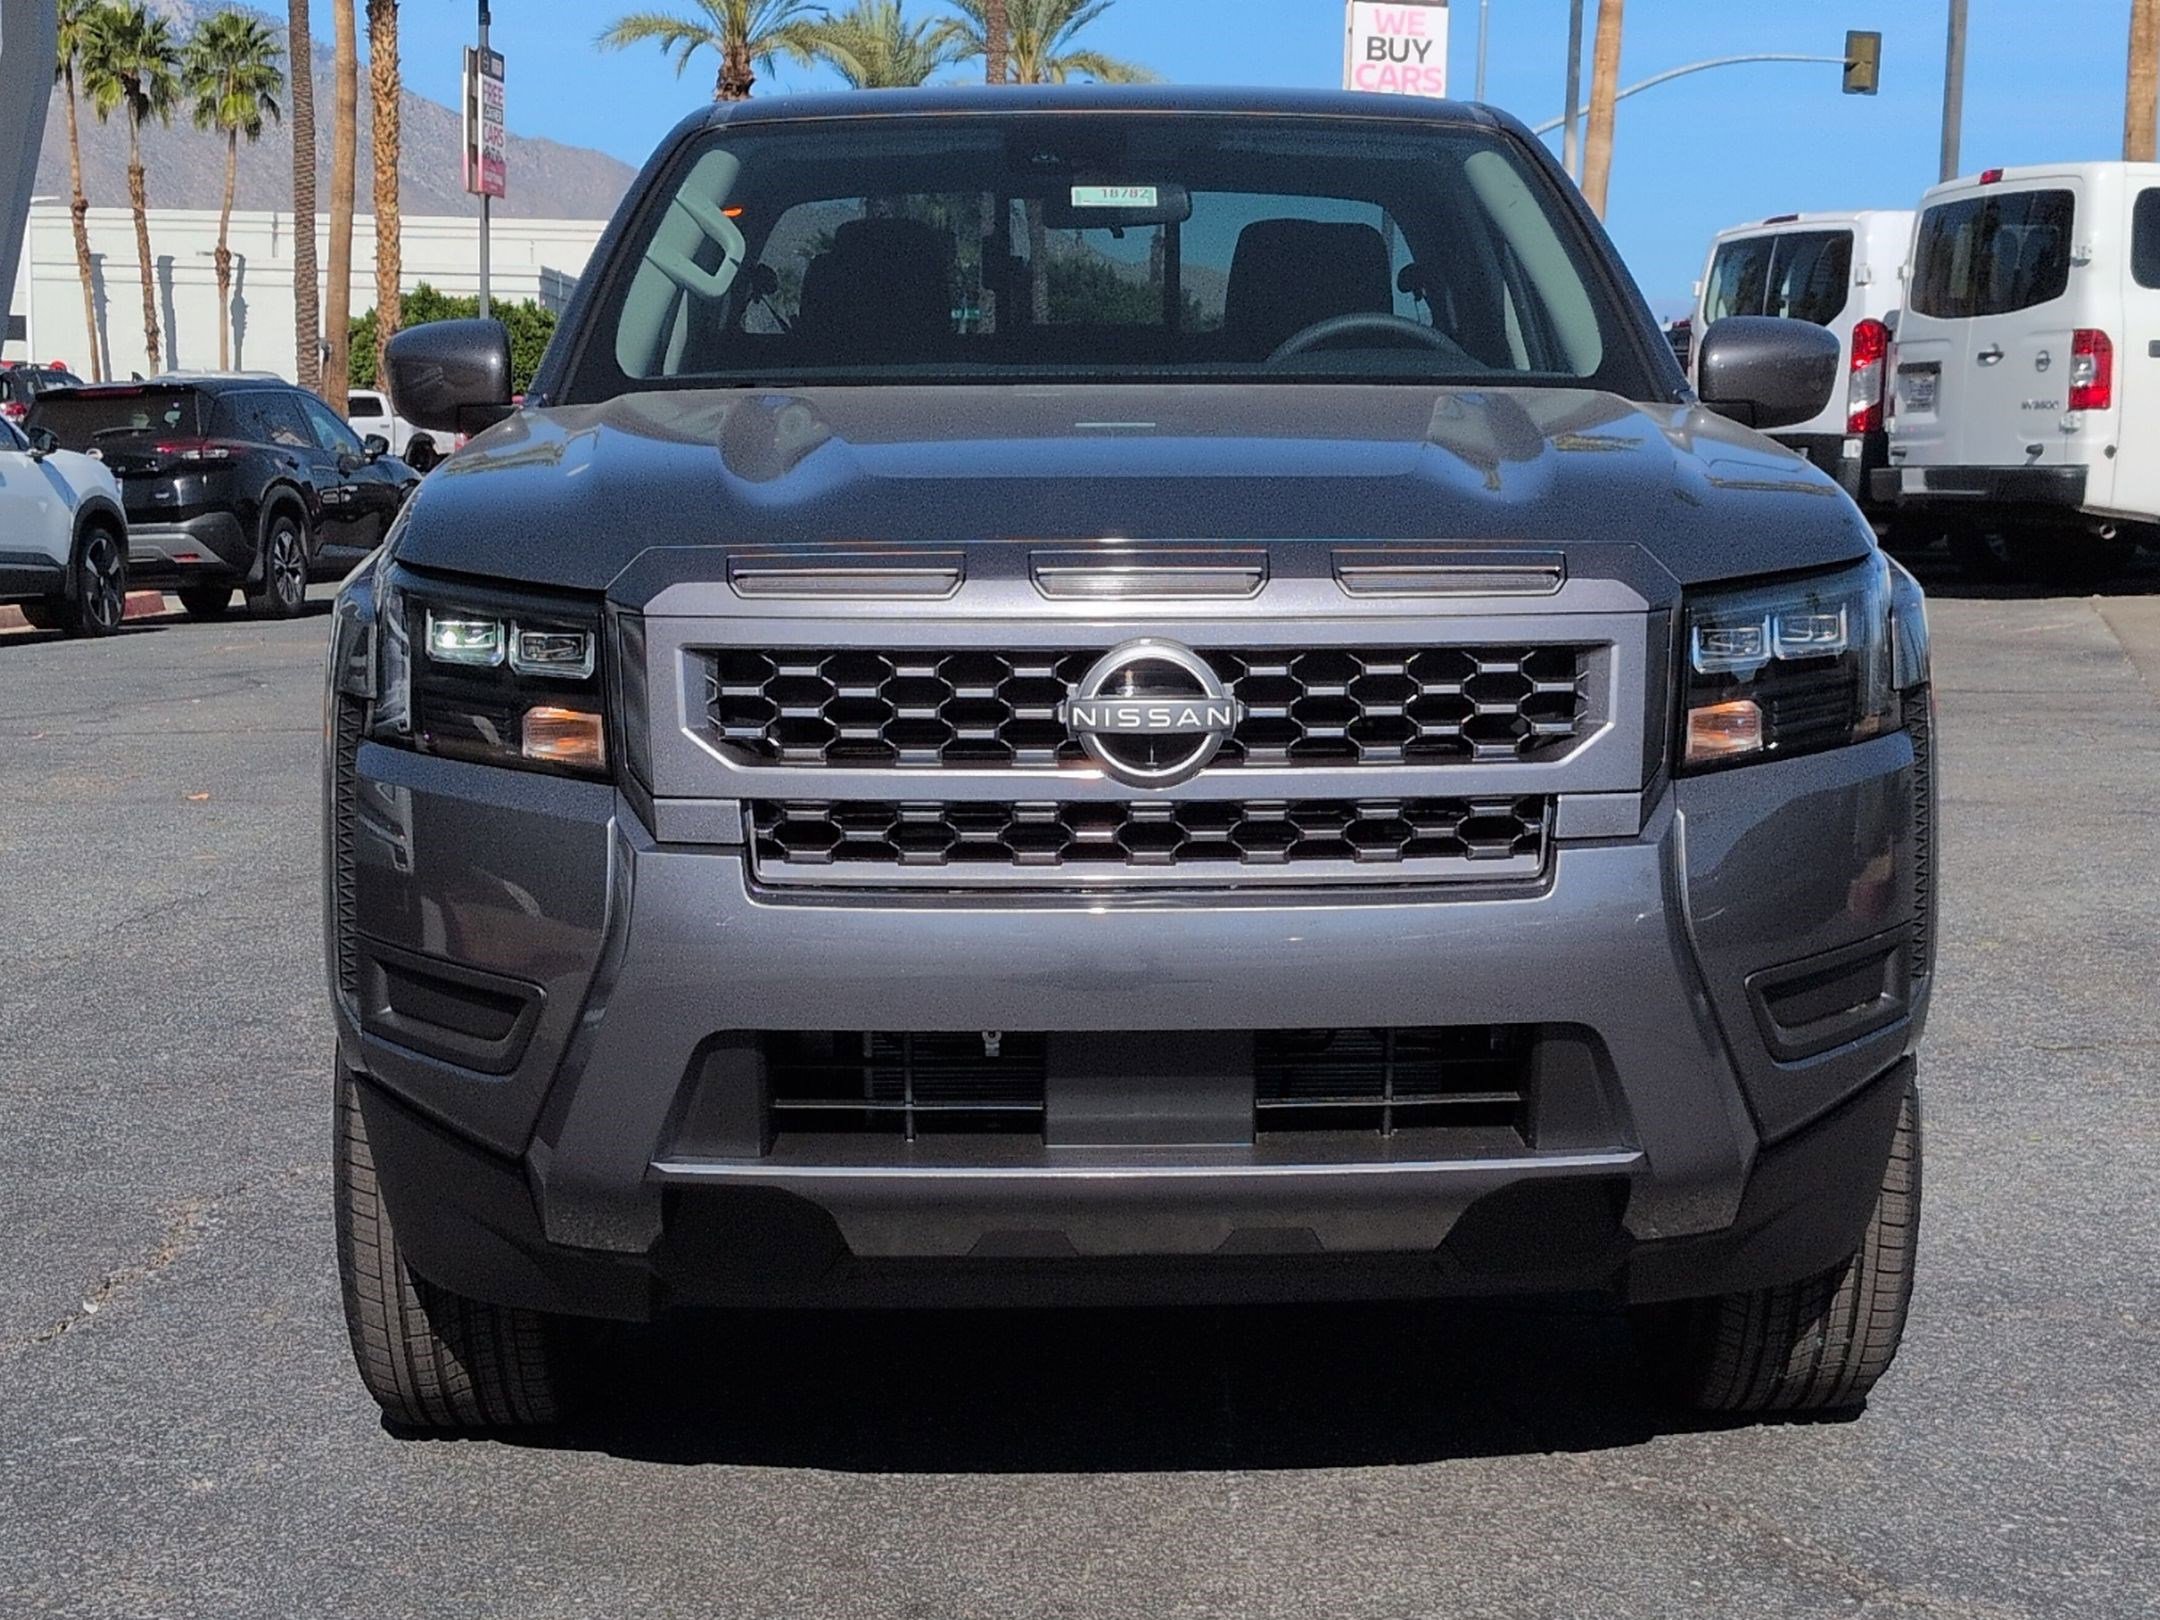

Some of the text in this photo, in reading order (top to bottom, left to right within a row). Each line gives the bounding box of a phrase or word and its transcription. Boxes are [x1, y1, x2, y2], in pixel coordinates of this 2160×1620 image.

[1375, 8, 1426, 36] WE
[1366, 36, 1432, 63] BUY
[1355, 63, 1442, 94] CARS
[1101, 188, 1149, 198] 18782
[1072, 706, 1232, 728] NISSAN
